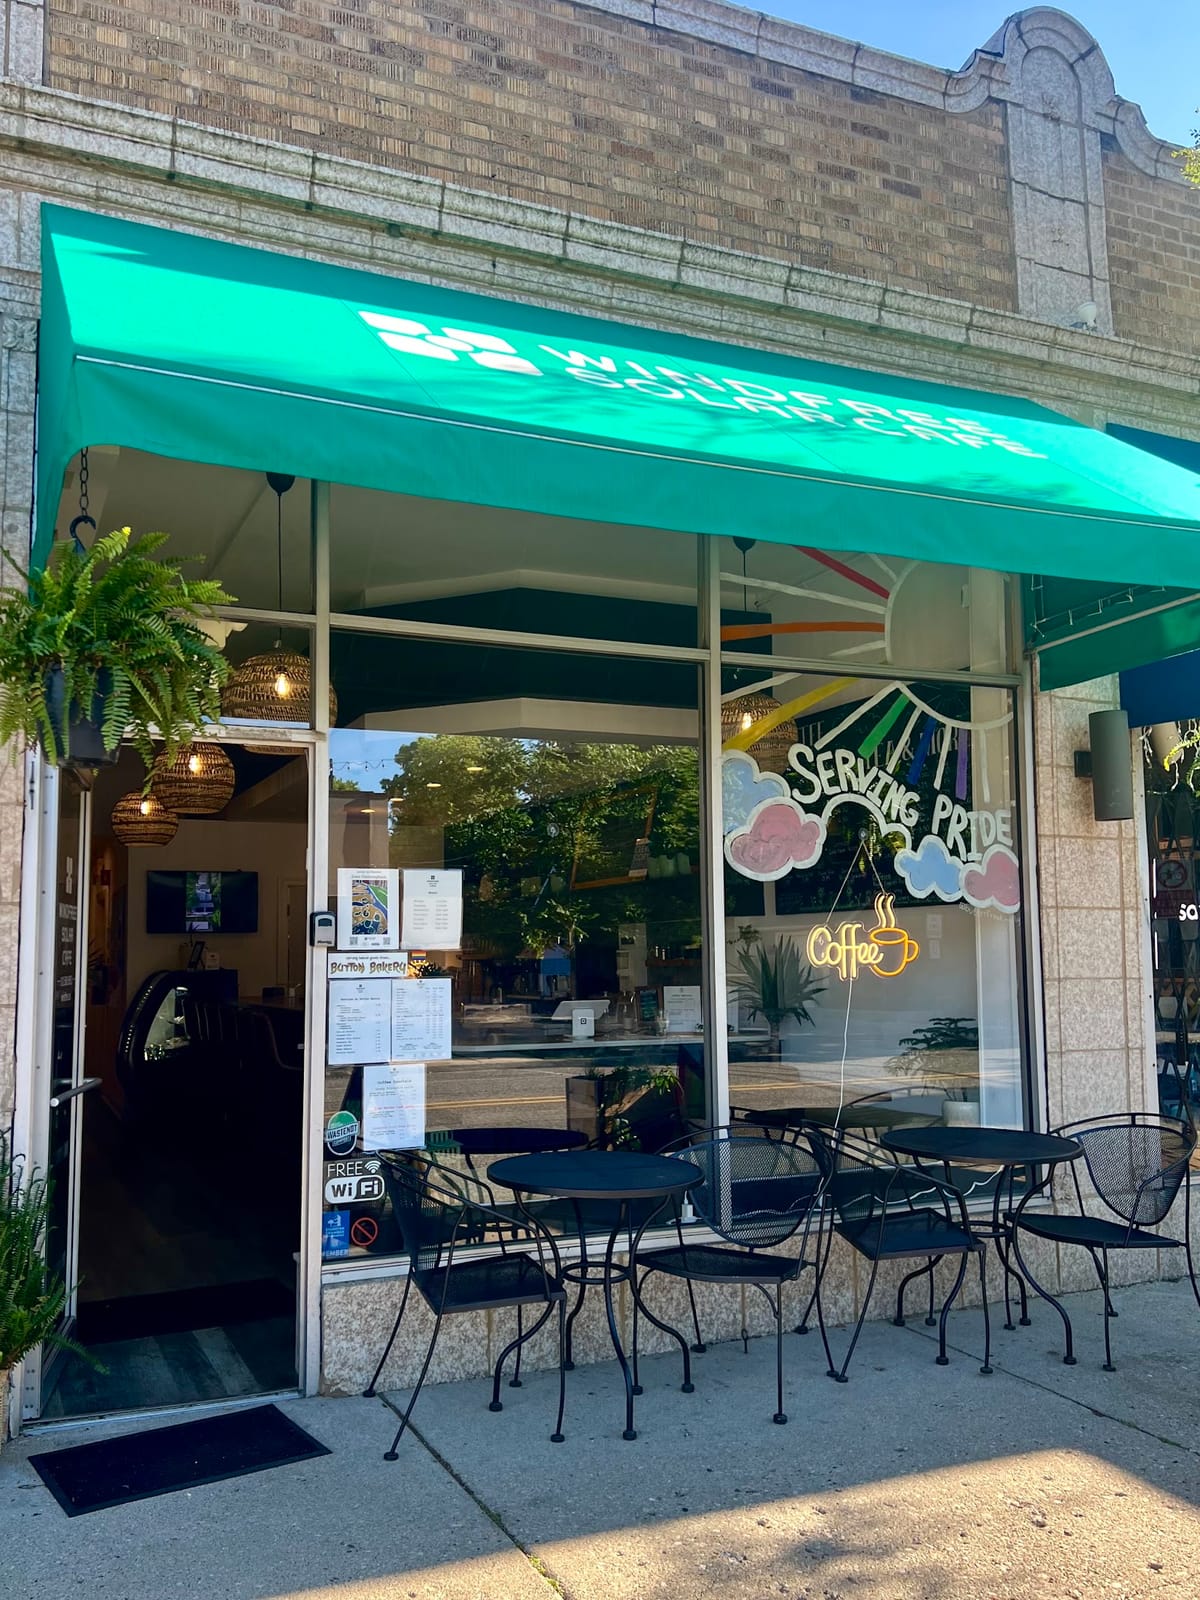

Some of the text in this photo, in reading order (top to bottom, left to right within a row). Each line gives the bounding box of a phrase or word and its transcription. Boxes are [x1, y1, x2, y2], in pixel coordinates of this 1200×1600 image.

[538, 345, 1008, 440] WINDFREE
[565, 367, 1048, 459] SOLAR CAFE
[788, 743, 1013, 862] SERVING PRIDE
[330, 961, 406, 974] BUTTON BAKERY
[808, 923, 884, 980] Coffee
[327, 1161, 363, 1177] FREE
